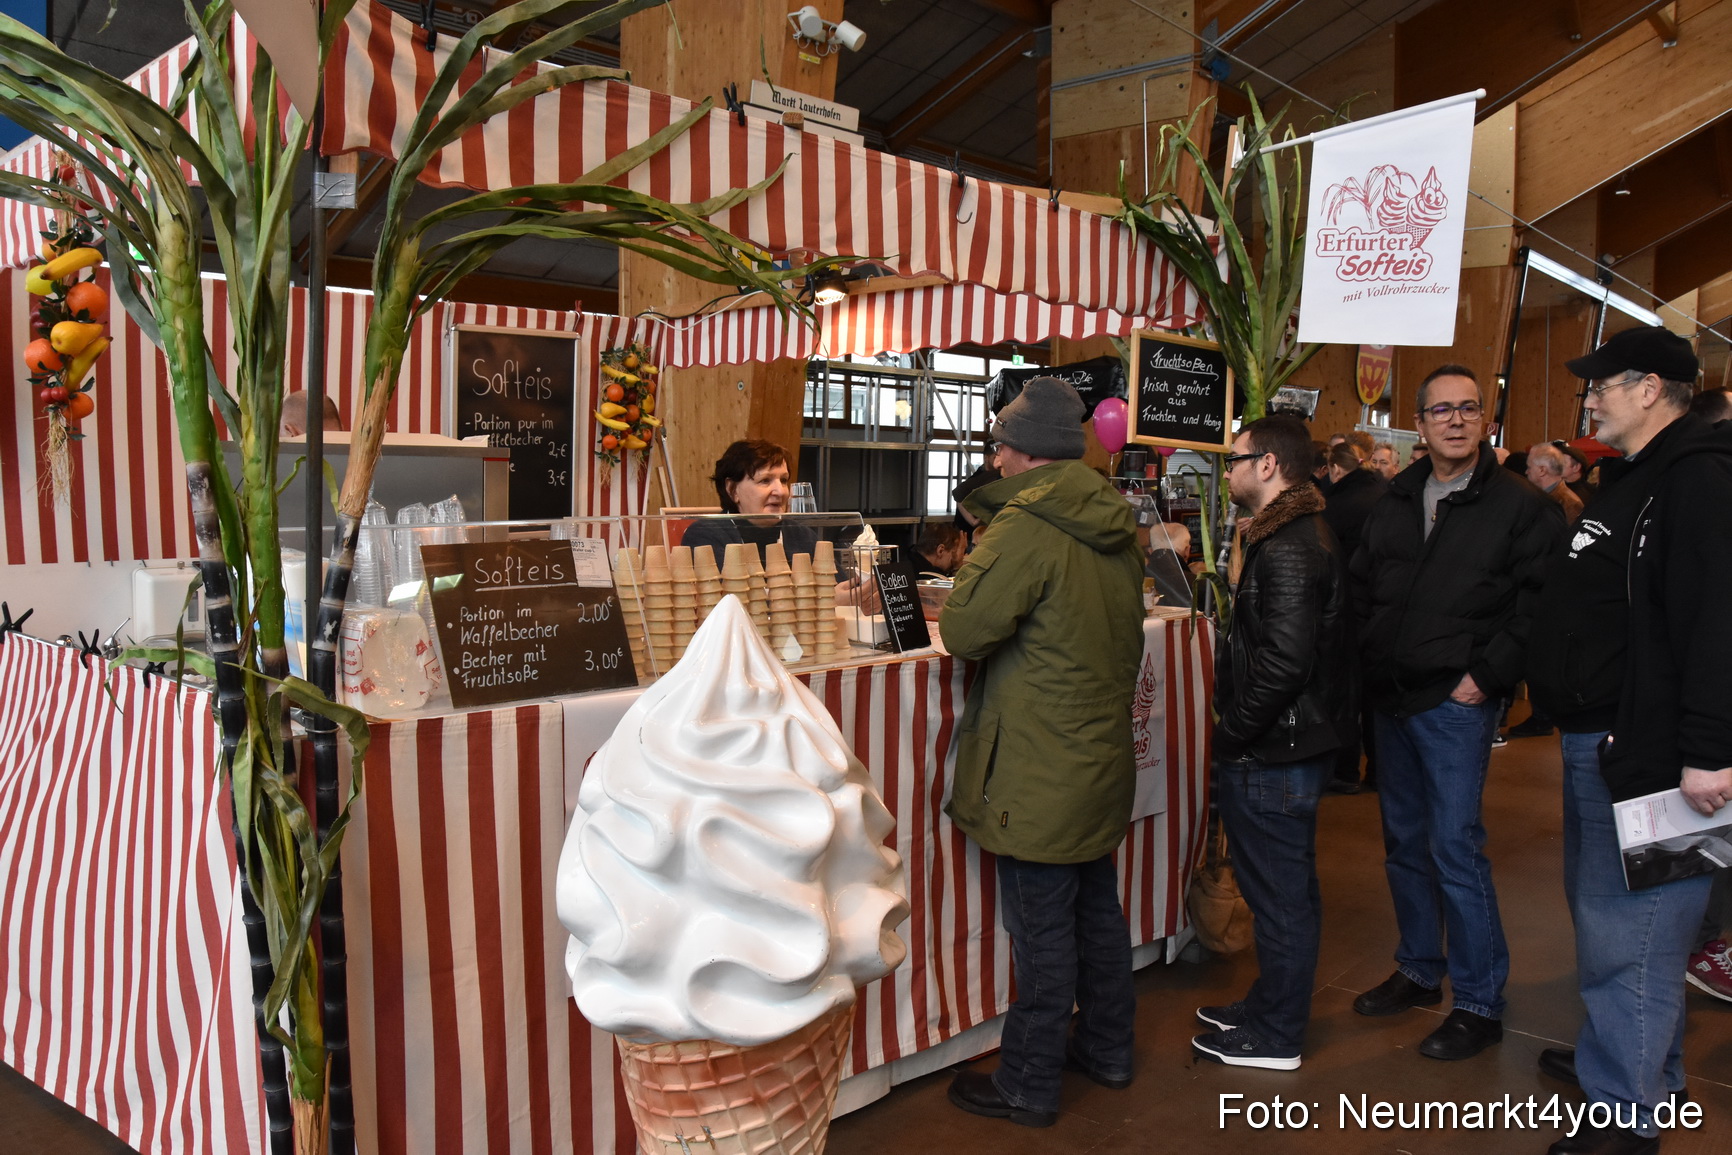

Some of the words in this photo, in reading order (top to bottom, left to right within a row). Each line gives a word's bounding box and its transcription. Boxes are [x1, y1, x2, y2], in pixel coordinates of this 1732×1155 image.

[799, 98, 841, 121] Lauterhofen
[1321, 232, 1409, 252] Erfurter
[1341, 252, 1427, 276] Softeis
[1342, 290, 1363, 303] mit
[1366, 282, 1451, 298] Vollrohrzucker
[1152, 347, 1214, 373] Fruchtsoßen
[472, 358, 552, 401] Softeis
[1142, 377, 1169, 394] frisch
[1175, 380, 1211, 396] gerührt
[1168, 397, 1187, 406] aus
[518, 419, 537, 432] pur
[541, 413, 554, 430] im
[1183, 414, 1200, 425] und
[1203, 414, 1222, 431] Honig
[474, 555, 565, 587] Softeis
[880, 572, 909, 588] Soßen
[460, 604, 505, 623] Portion
[517, 602, 532, 618] im
[460, 620, 560, 646] Waffelbecher
[462, 650, 514, 669] Becher
[524, 644, 548, 662] mit
[461, 664, 540, 688] Fruchtsoße
